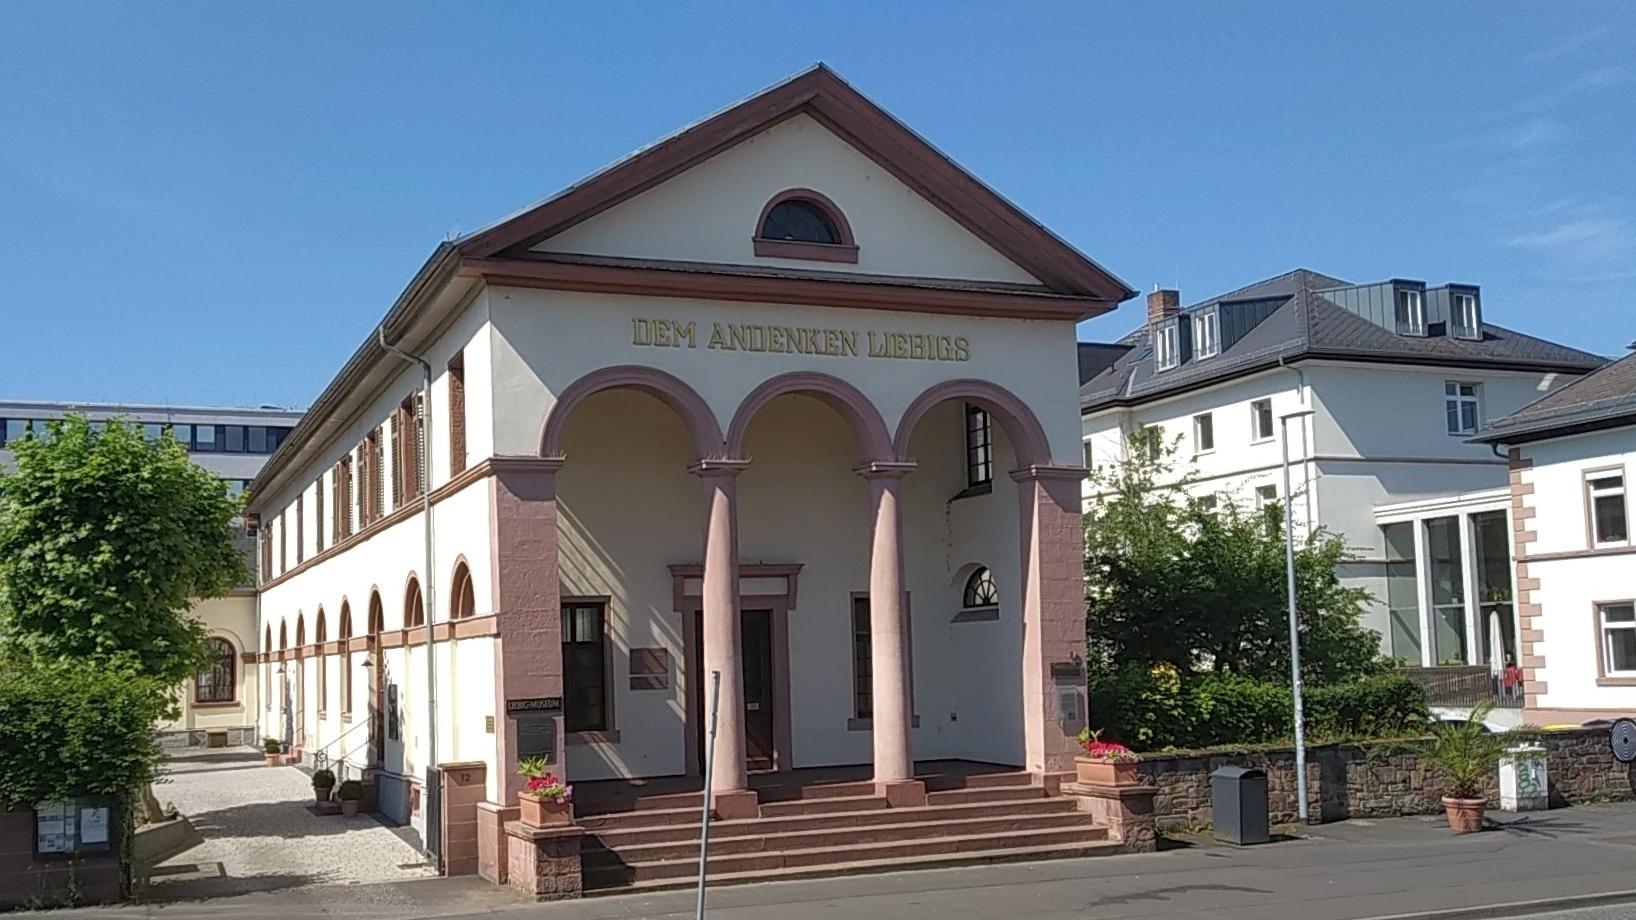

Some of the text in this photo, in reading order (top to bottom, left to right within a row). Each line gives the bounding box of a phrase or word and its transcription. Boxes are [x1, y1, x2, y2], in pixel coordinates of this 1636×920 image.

[632, 318, 971, 361] DEM ANDENKEN LIEBIGS
